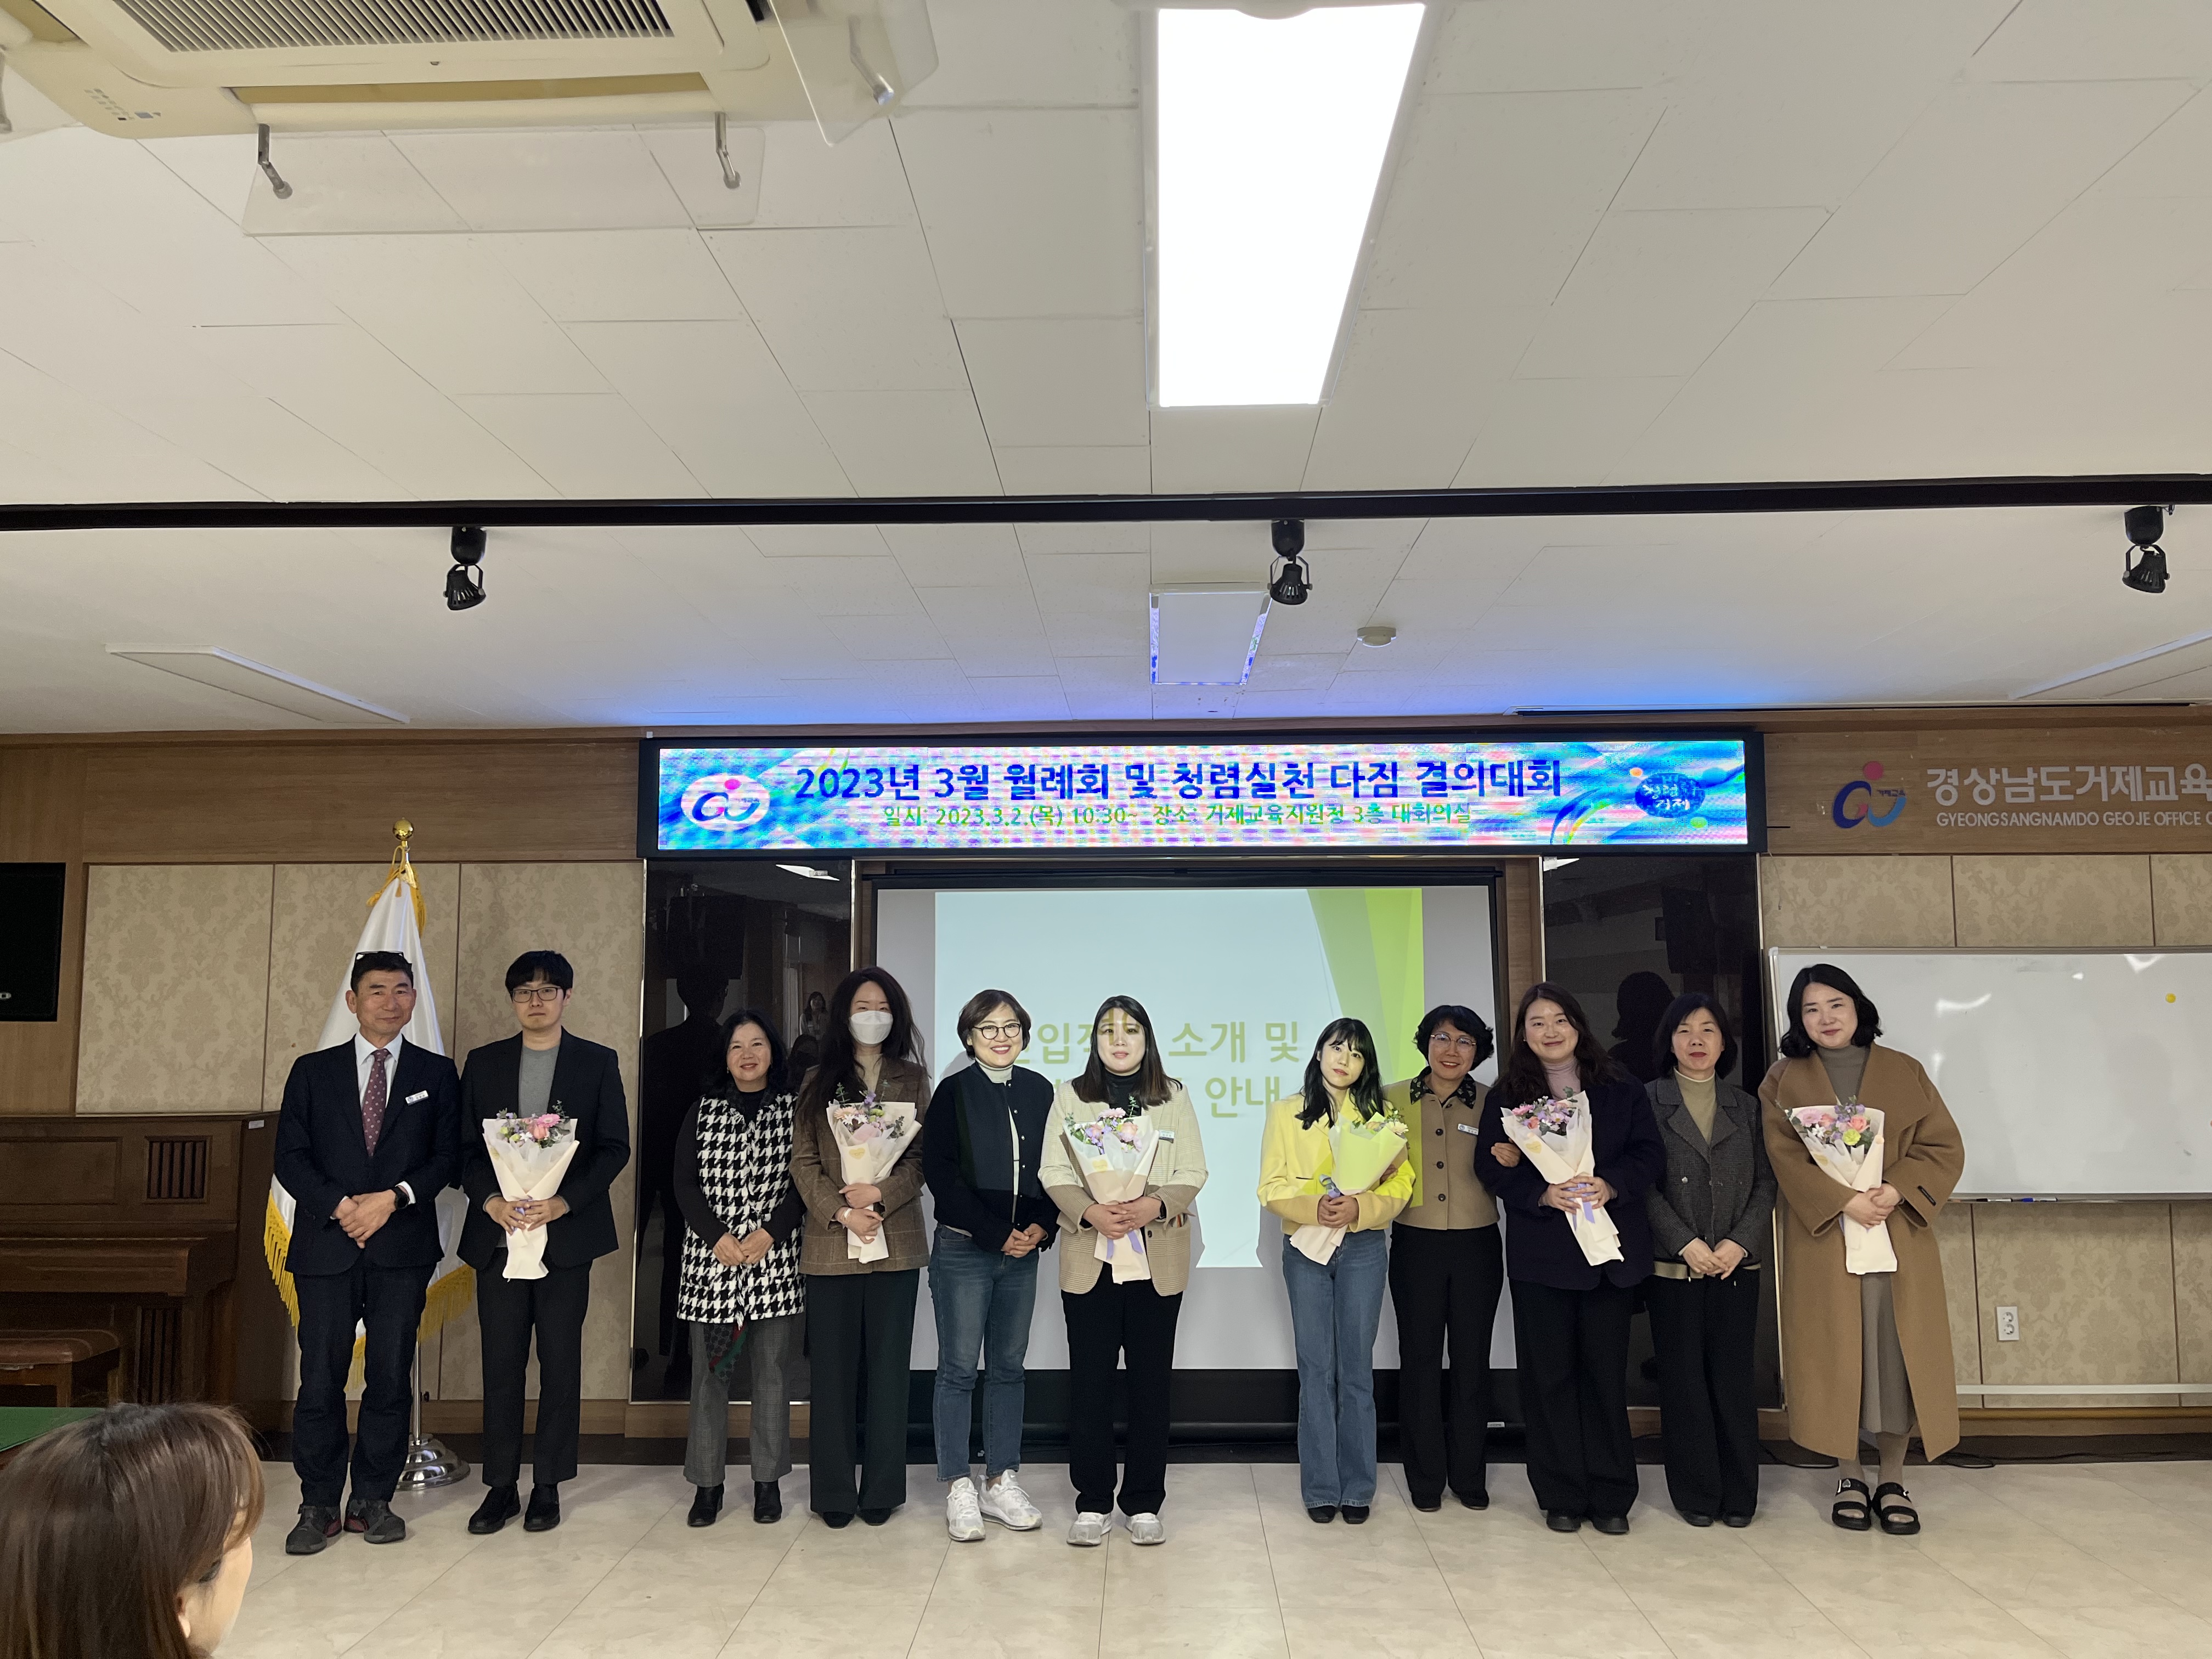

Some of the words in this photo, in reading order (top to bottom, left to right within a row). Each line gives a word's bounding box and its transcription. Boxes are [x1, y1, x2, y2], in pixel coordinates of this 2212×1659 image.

[795, 764, 921, 800] 2023년
[934, 764, 989, 800] 3월
[1003, 764, 1109, 800] 월례회
[1125, 763, 1158, 799] 및
[1171, 762, 1315, 799] 청렴실천
[1330, 761, 1398, 798] 다짐
[1415, 760, 1561, 797] 결의대회
[1926, 763, 2212, 806] 경상남도거제교육
[884, 806, 928, 826] 일시:
[935, 805, 1063, 827] 2023.3.2.(목)
[1071, 806, 1138, 824] 10:30~
[1153, 805, 1198, 825] 장소:
[1205, 804, 1345, 825] 거제교육지원청
[1352, 803, 1384, 823] 3층
[1391, 802, 1471, 823] 대회의실
[1936, 811, 2100, 827] GYEONGSANGNAMDO
[2102, 811, 2151, 826] GEOJE
[2153, 811, 2202, 826] OFFICE
[1168, 1021, 1246, 1063] 소개
[1265, 1021, 1299, 1063] 및
[1205, 1076, 1280, 1118] 안내
